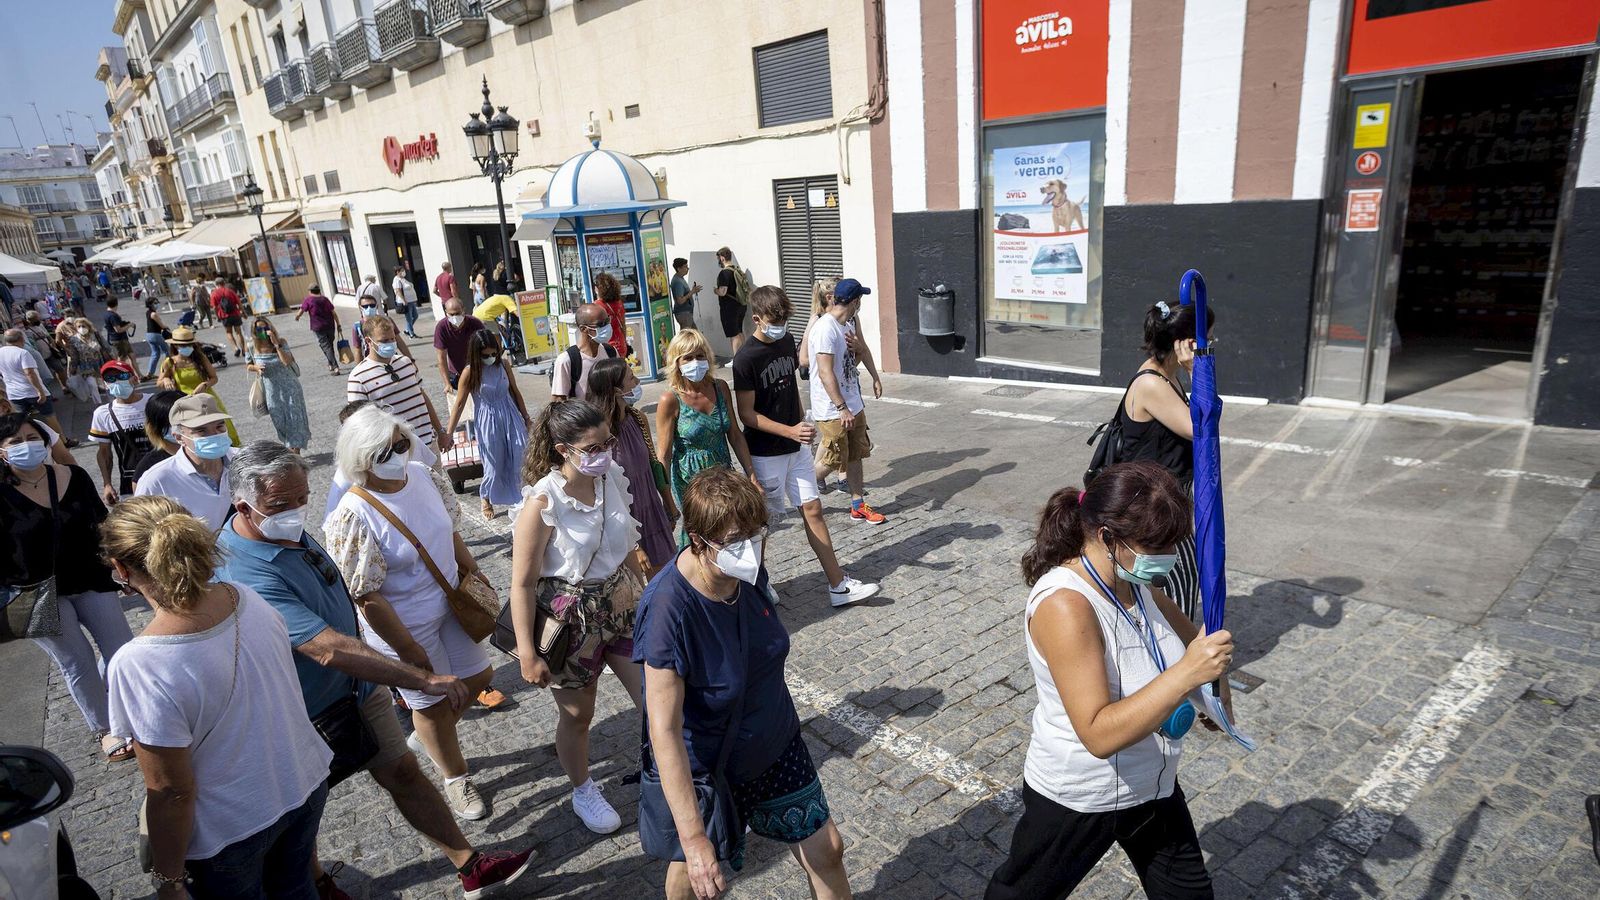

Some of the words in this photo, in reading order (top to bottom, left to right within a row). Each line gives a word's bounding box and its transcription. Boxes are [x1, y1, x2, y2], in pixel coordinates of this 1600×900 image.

[403, 132, 439, 161] market
[1047, 156, 1056, 164] de
[1019, 165, 1064, 177] verano
[521, 293, 545, 303] Ahorra
